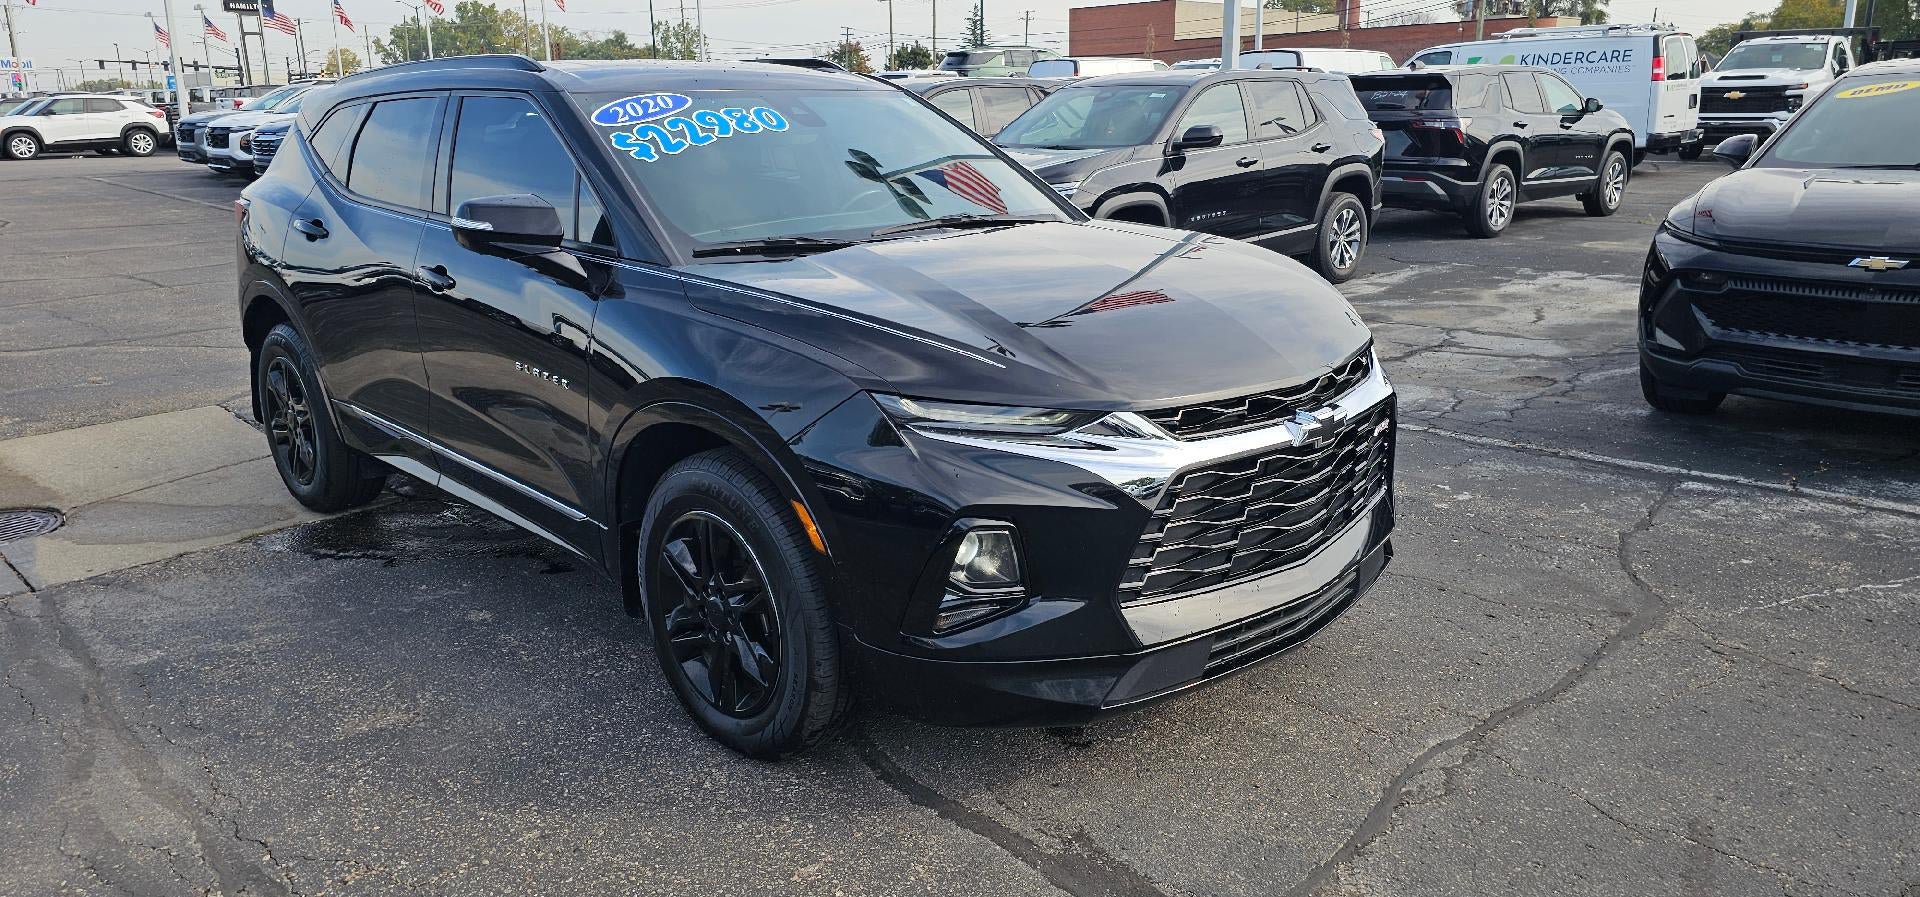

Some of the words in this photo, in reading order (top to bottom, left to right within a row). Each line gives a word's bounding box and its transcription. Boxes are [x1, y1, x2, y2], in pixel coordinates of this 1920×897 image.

[1520, 49, 1633, 65] KINDERCARE
[1570, 65, 1631, 75] COMPANIES
[609, 95, 673, 123] 2020
[610, 106, 789, 162] $22980
[515, 361, 569, 390] BLAZER
